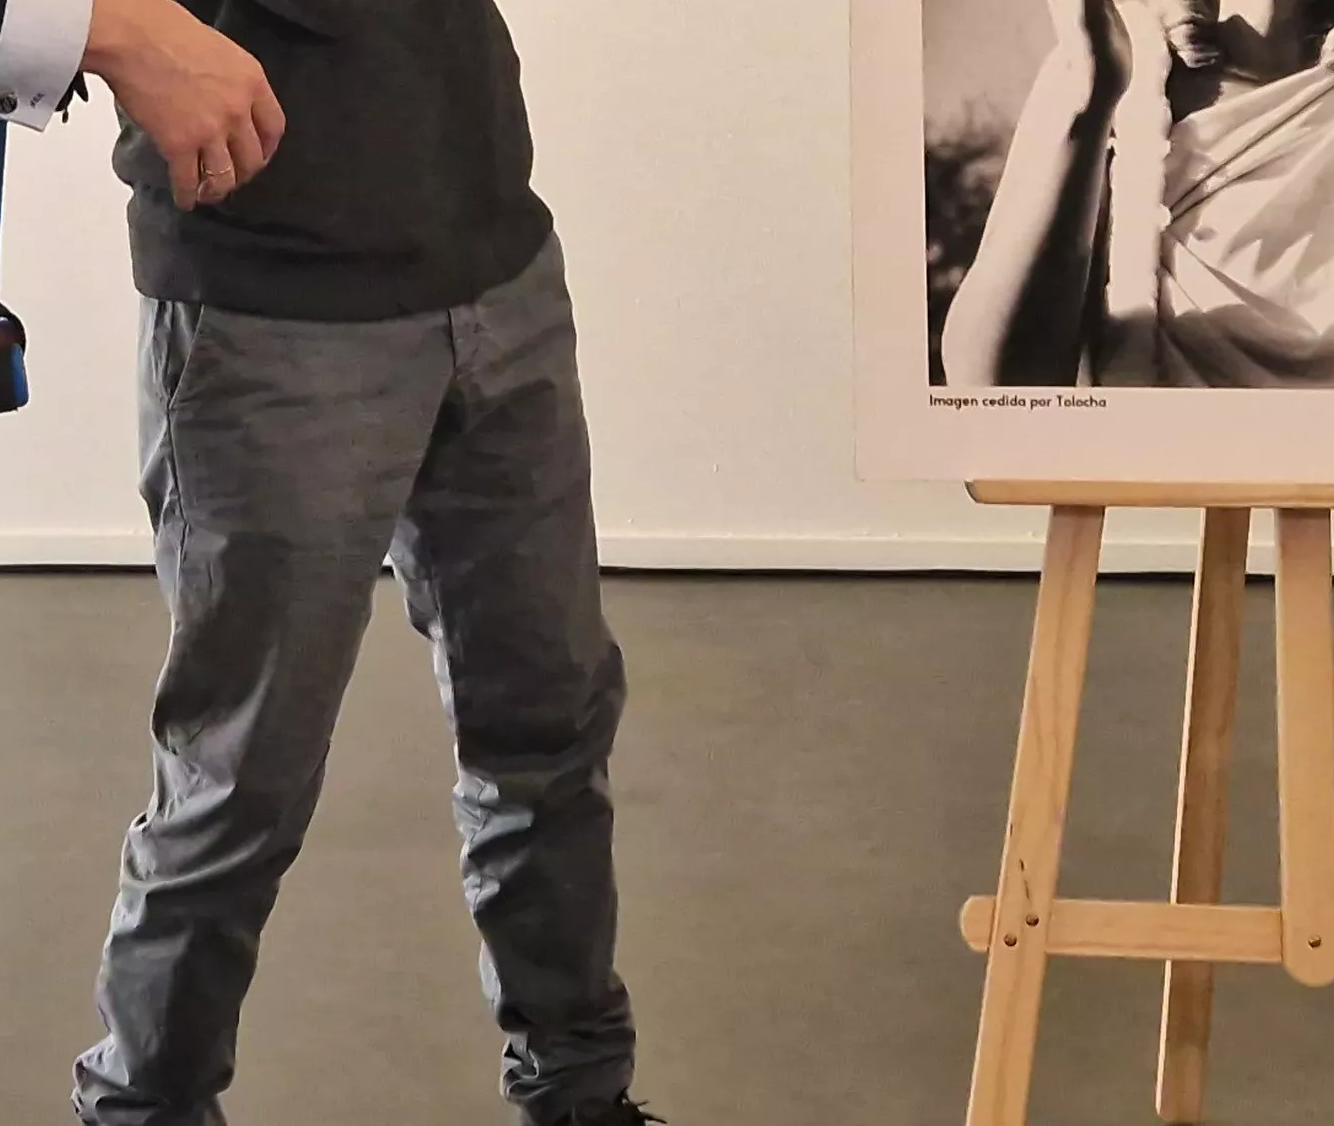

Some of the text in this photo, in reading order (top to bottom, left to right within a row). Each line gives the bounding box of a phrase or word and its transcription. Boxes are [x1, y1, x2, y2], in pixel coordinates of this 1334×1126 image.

[929, 393, 1107, 412] Imagen cedida por Tolocha
